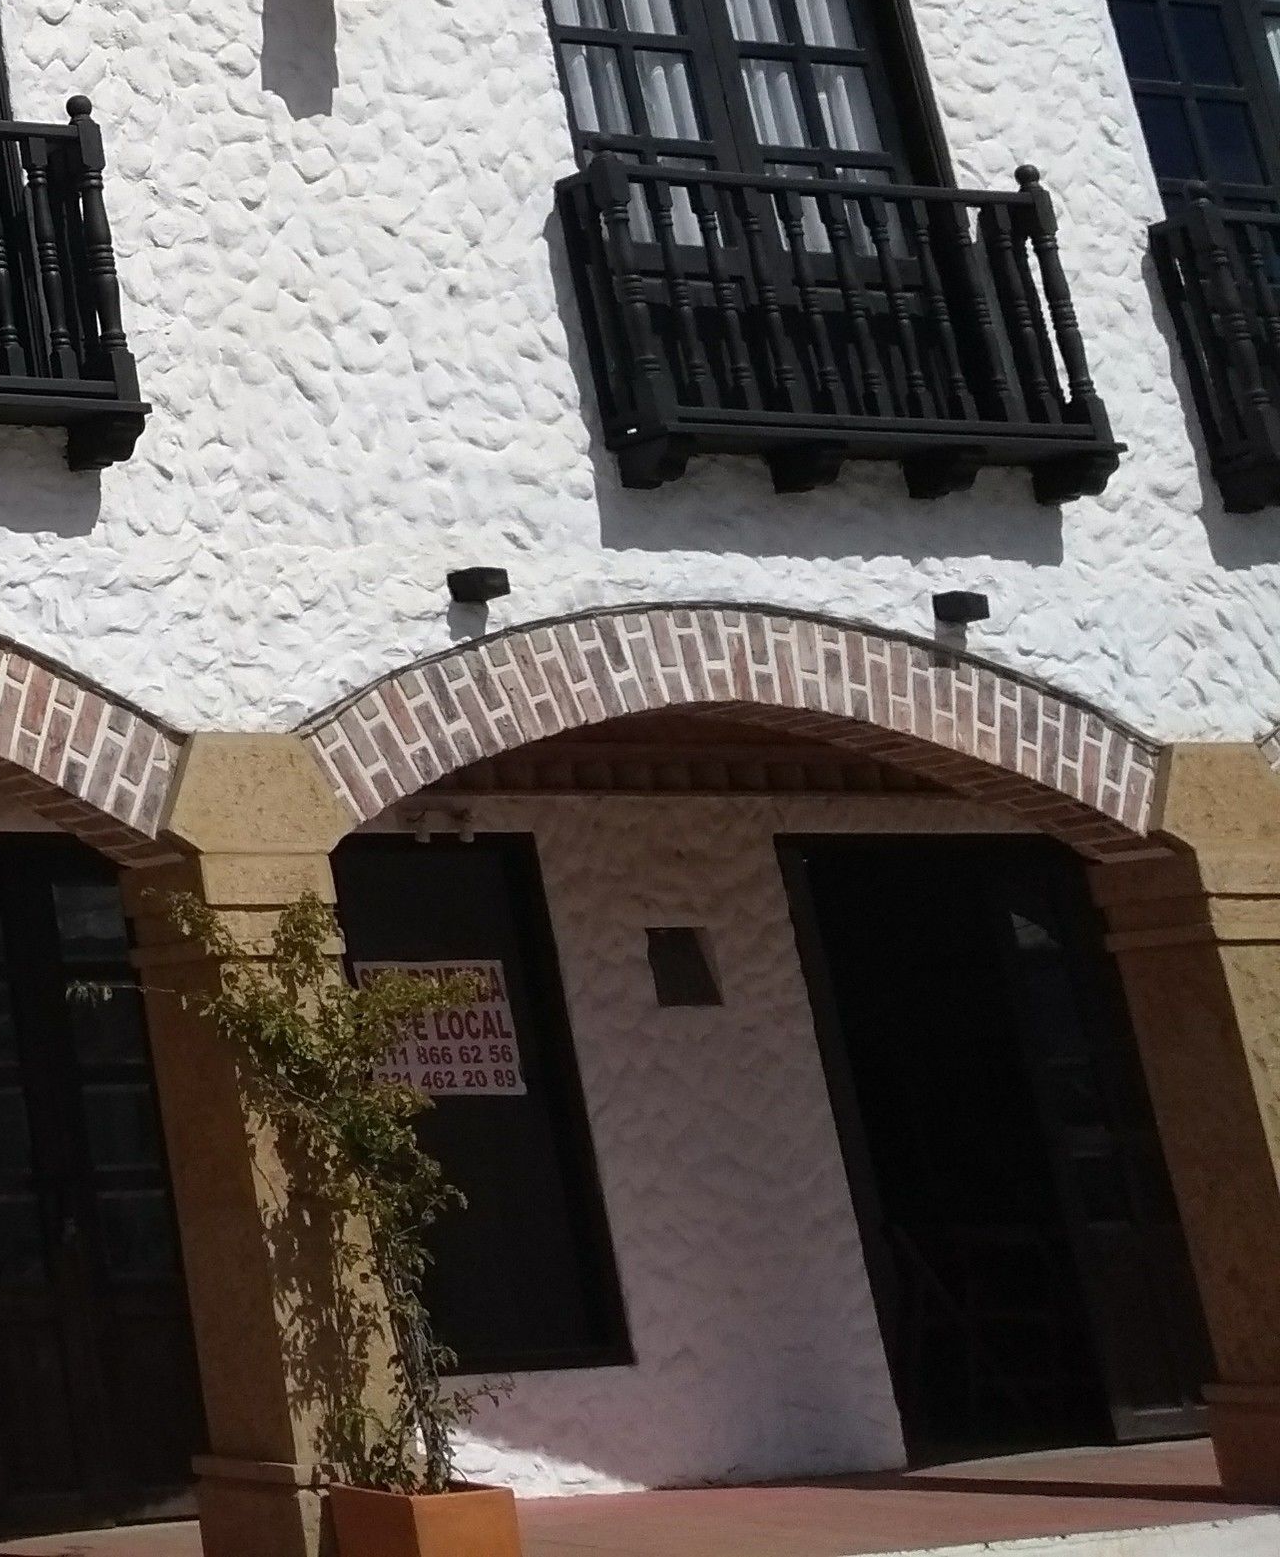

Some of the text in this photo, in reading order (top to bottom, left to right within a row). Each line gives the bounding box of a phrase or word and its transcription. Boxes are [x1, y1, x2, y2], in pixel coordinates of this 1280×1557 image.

[433, 1009, 513, 1041] LOCAL
[416, 1045, 453, 1065] 866
[459, 1045, 483, 1064] 62
[489, 1044, 513, 1063] 56
[421, 1070, 457, 1089] 462
[462, 1070, 488, 1087] 20
[493, 1069, 517, 1087] 89
